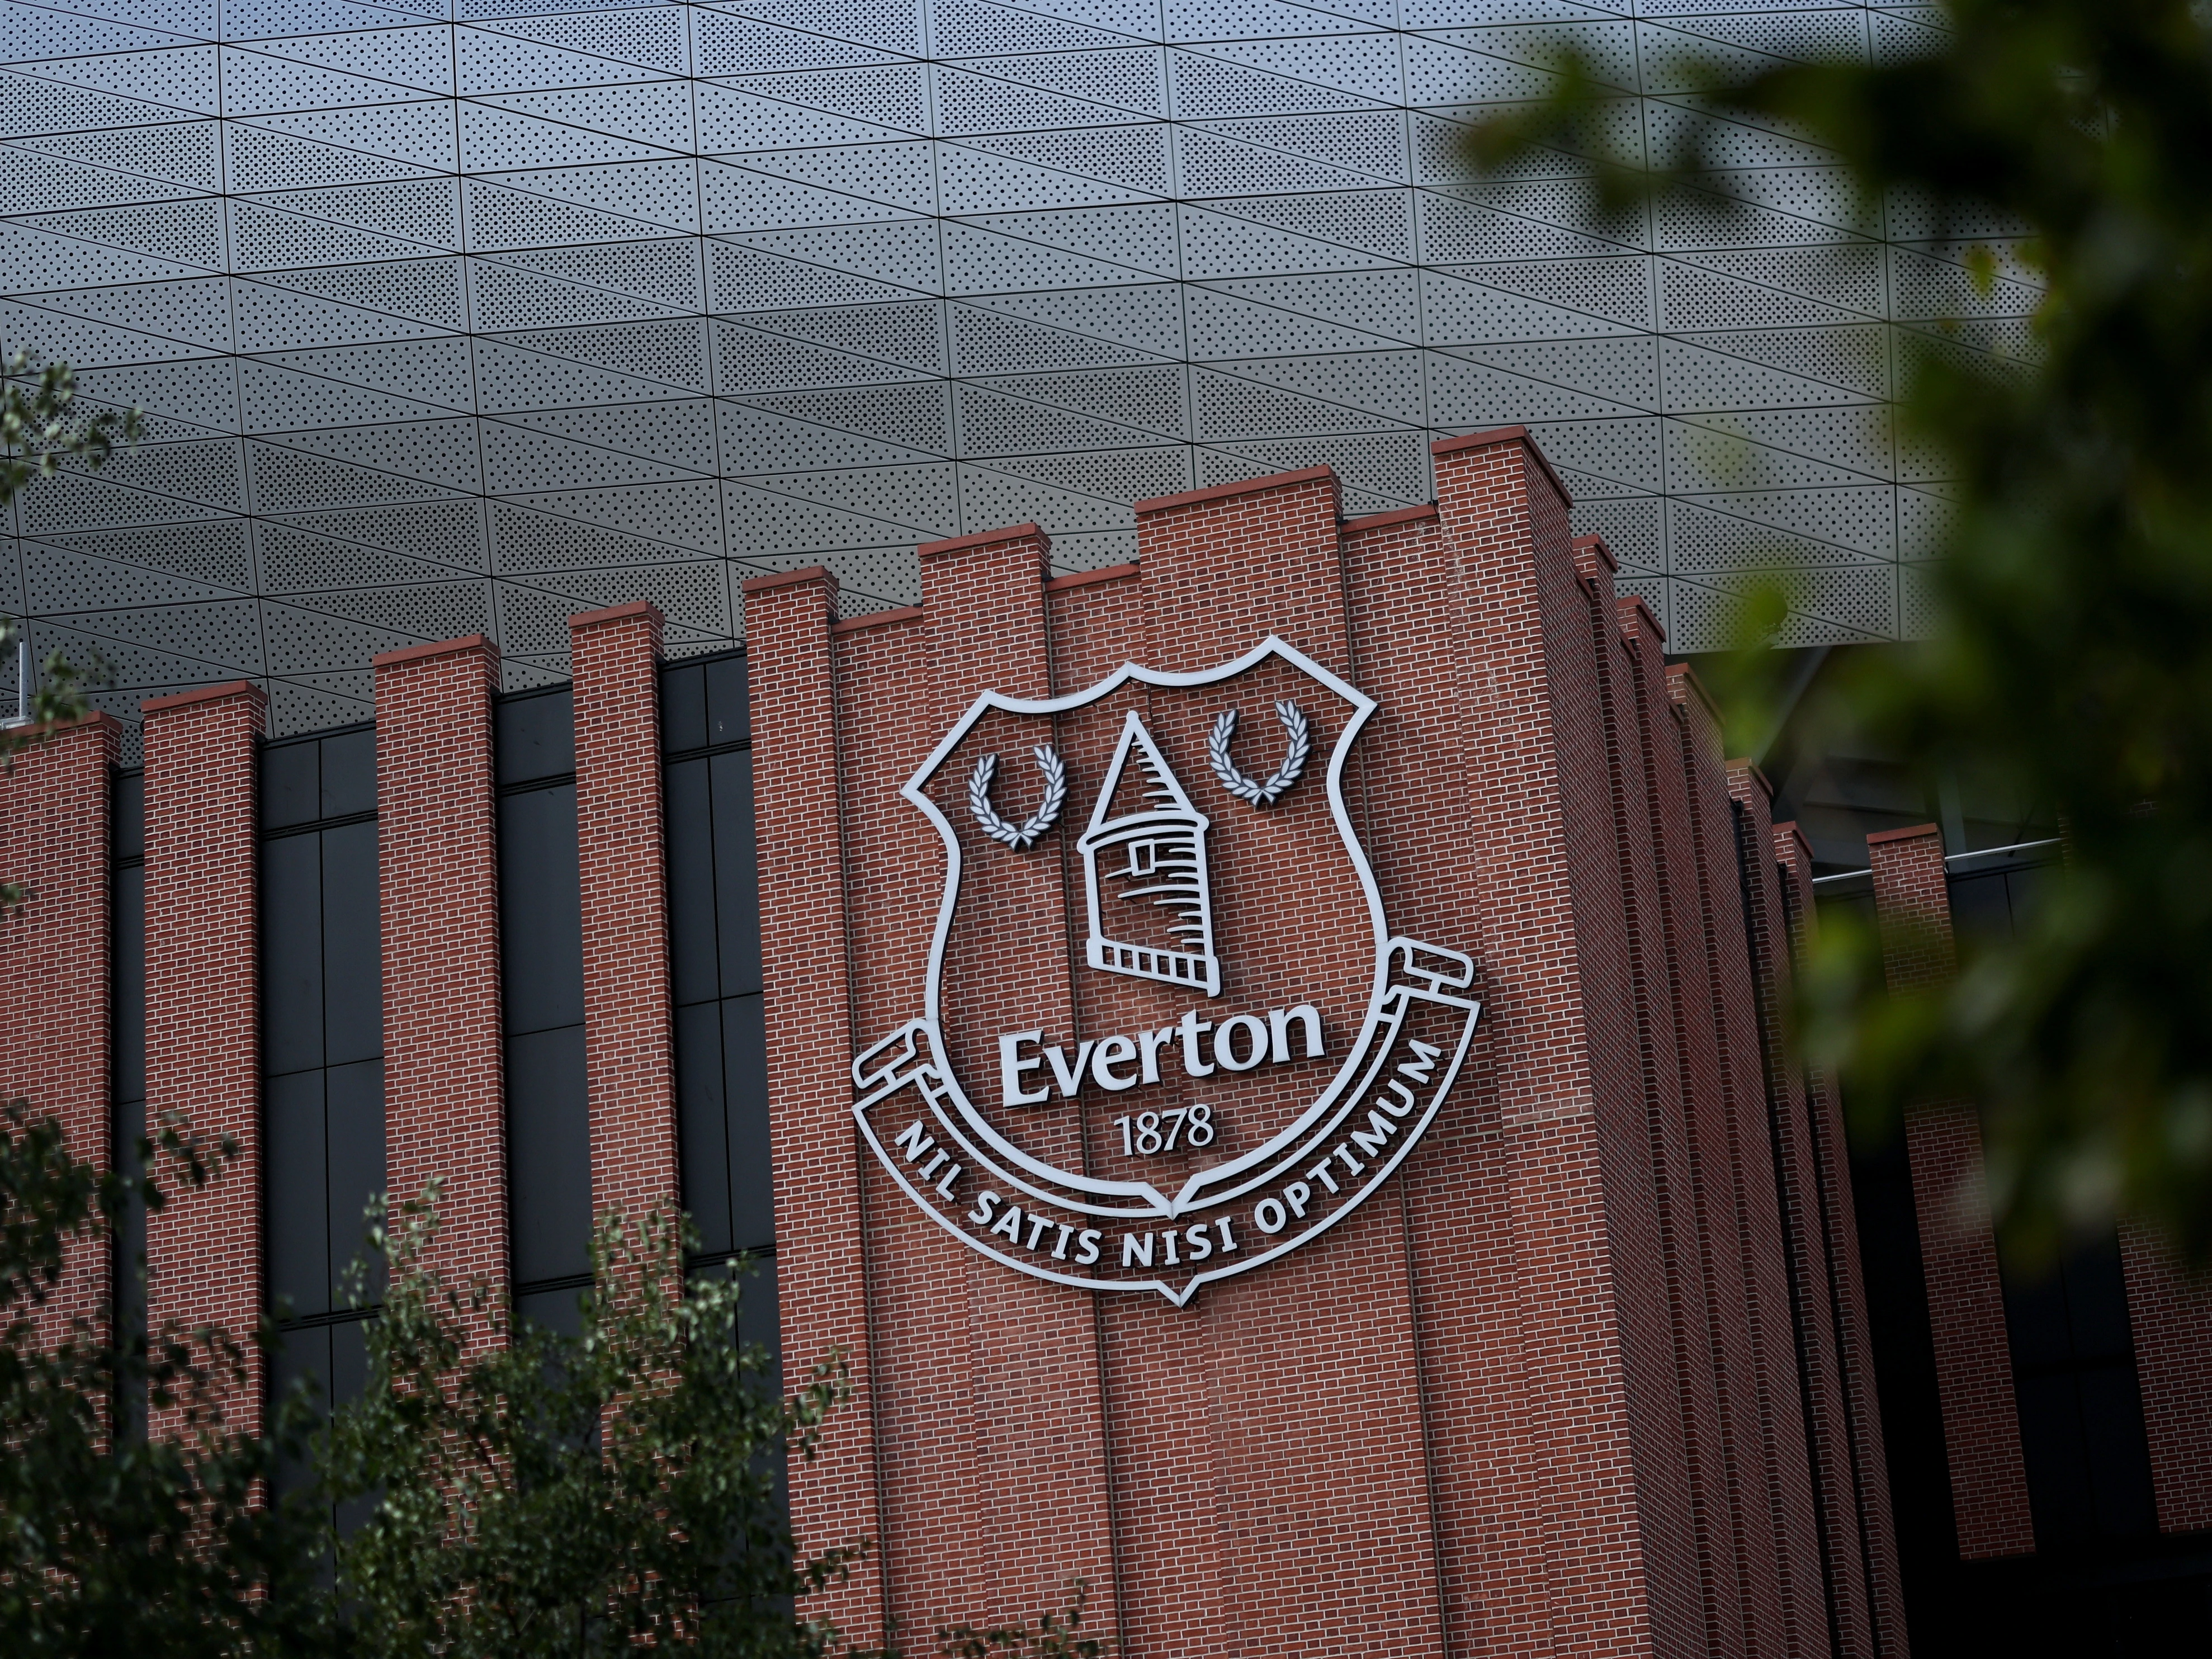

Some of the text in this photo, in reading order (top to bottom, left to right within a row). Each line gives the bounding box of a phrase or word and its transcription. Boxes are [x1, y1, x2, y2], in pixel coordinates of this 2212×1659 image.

[999, 1005, 1325, 1107] Everton
[895, 1039, 1442, 1267] NIL SATIS NISI OPTIMUM
[1114, 1104, 1214, 1156] 1878
